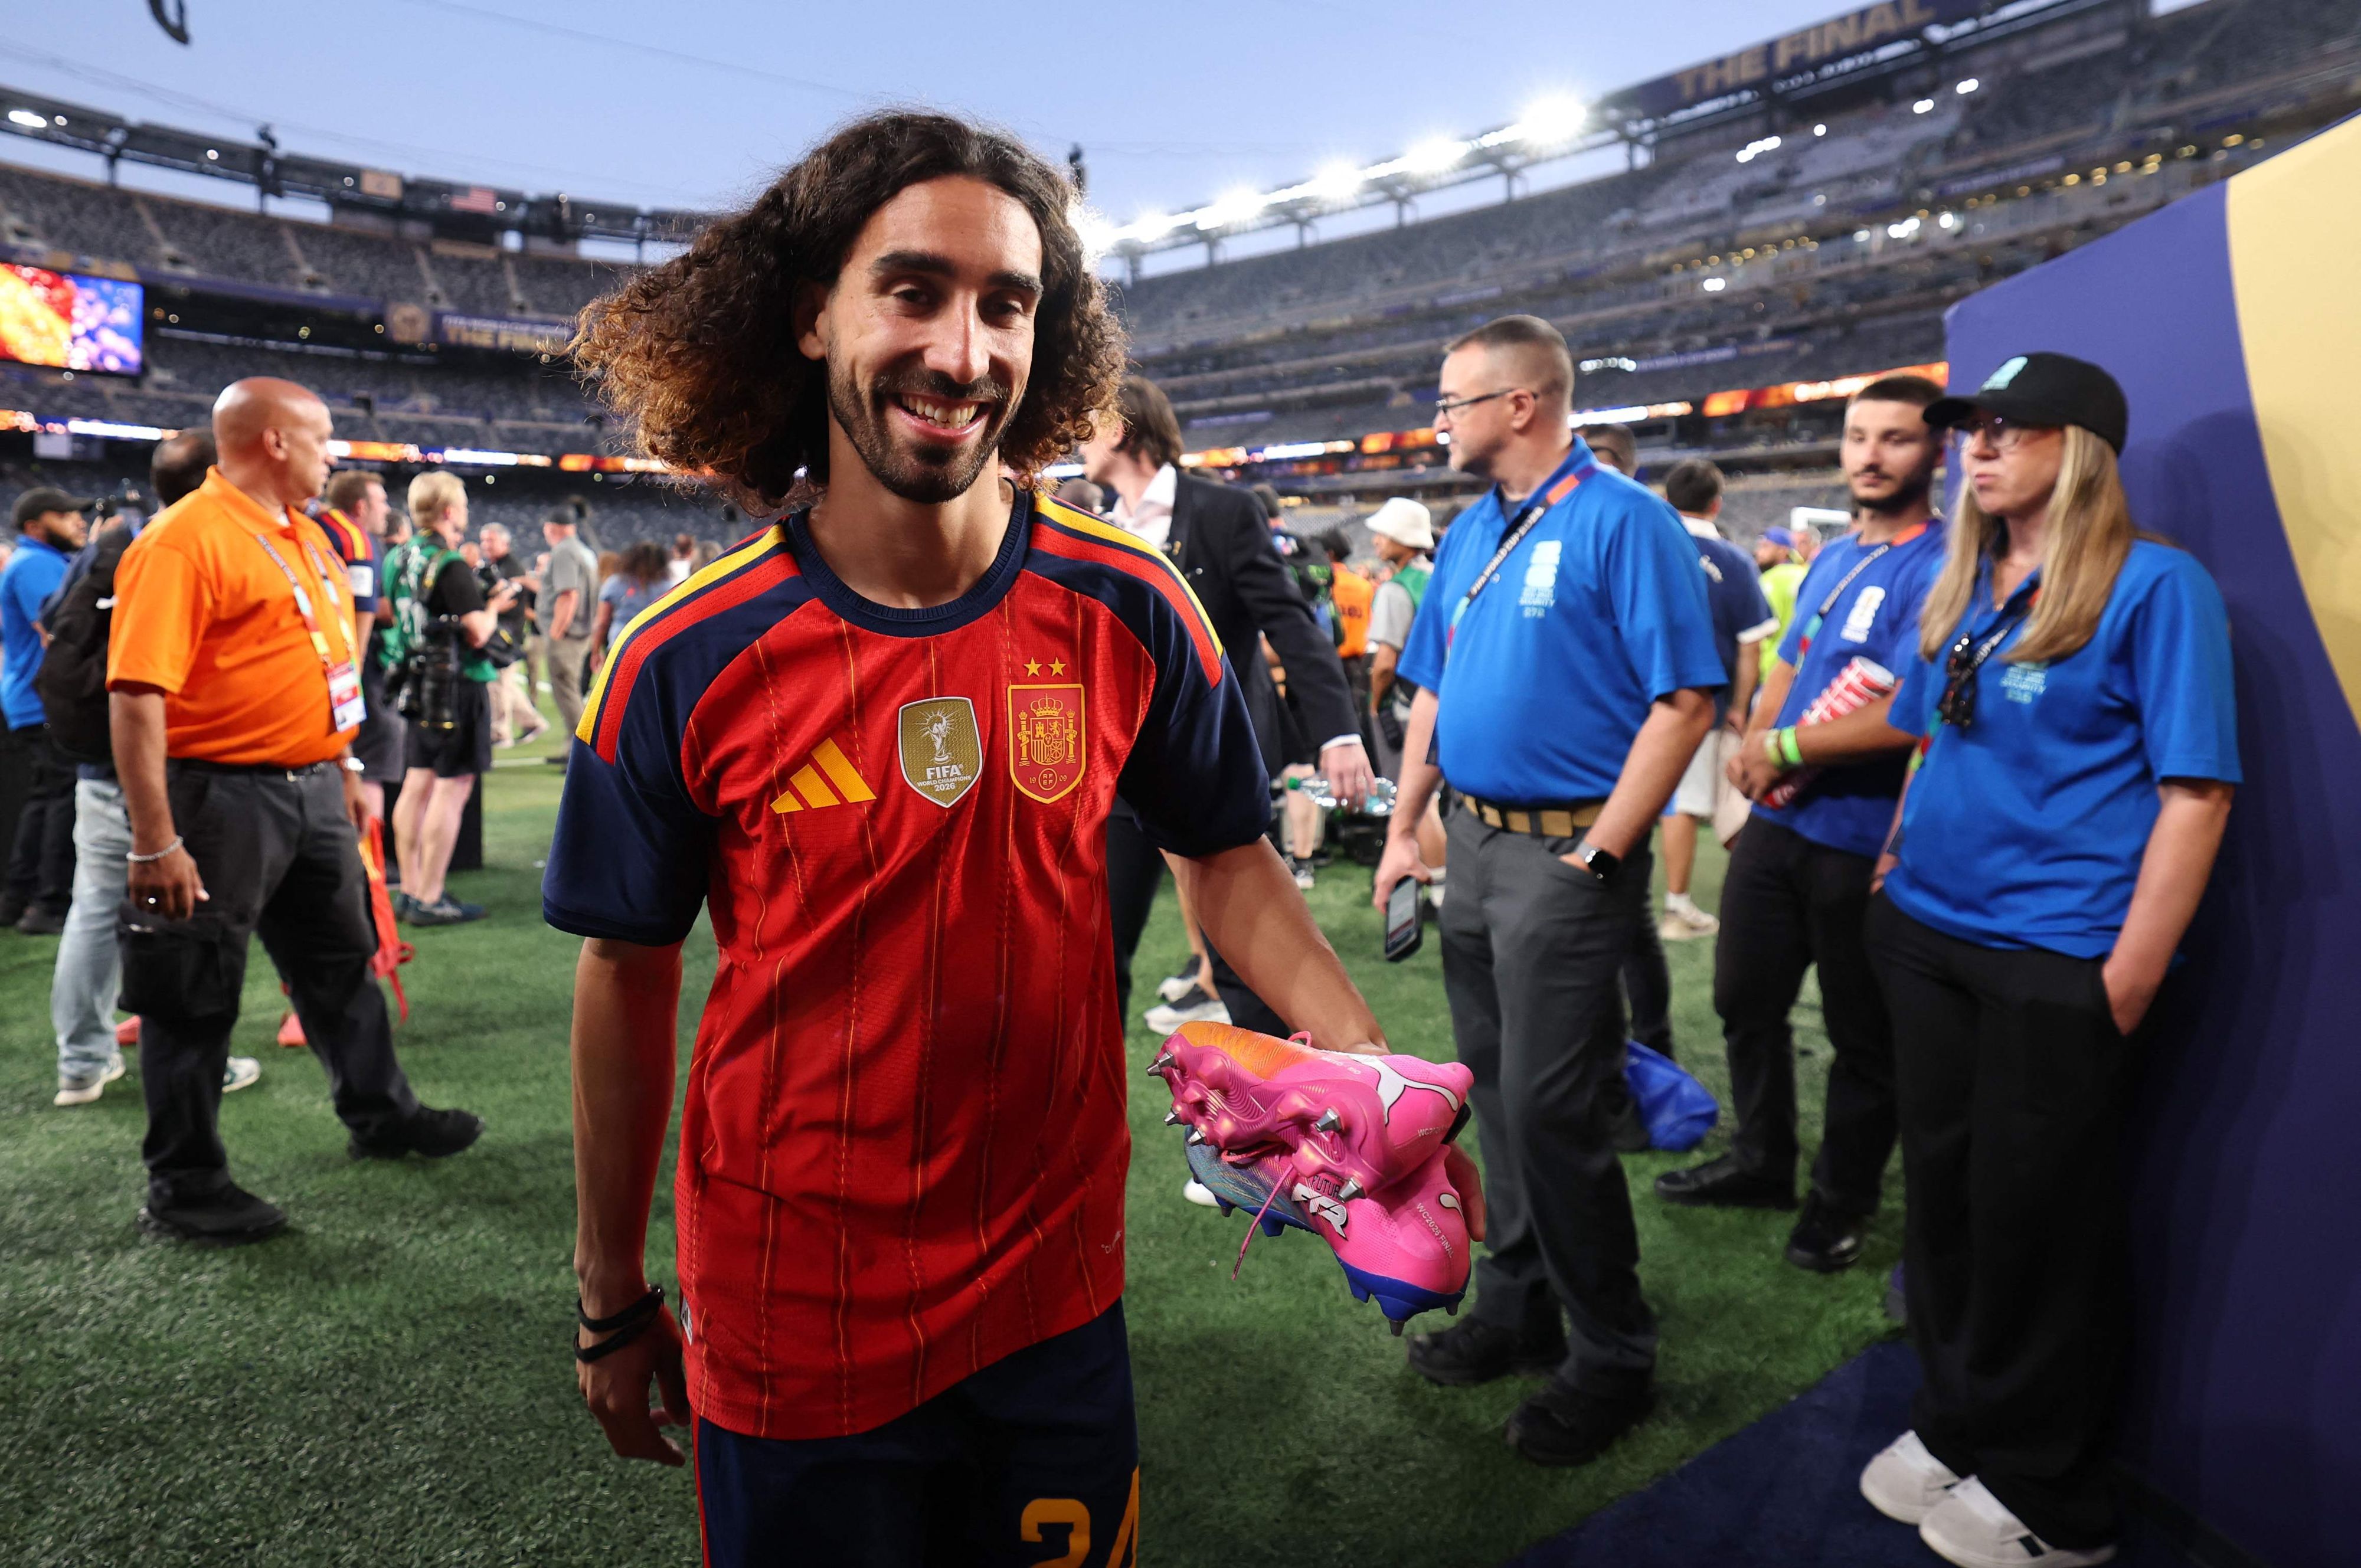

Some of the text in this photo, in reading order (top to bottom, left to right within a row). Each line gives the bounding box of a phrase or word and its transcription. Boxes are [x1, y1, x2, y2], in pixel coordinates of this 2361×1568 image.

[1674, 0, 1935, 99] THE FINAL
[1482, 547, 1508, 578] WORLD
[1502, 532, 1520, 552] CUP
[926, 765, 962, 780] FIFA
[938, 775, 972, 784] CHAMPIONS
[934, 783, 956, 791] 2026
[1312, 1174, 1341, 1200] FUTUR
[1417, 1203, 1454, 1259] WC2026 FINAL
